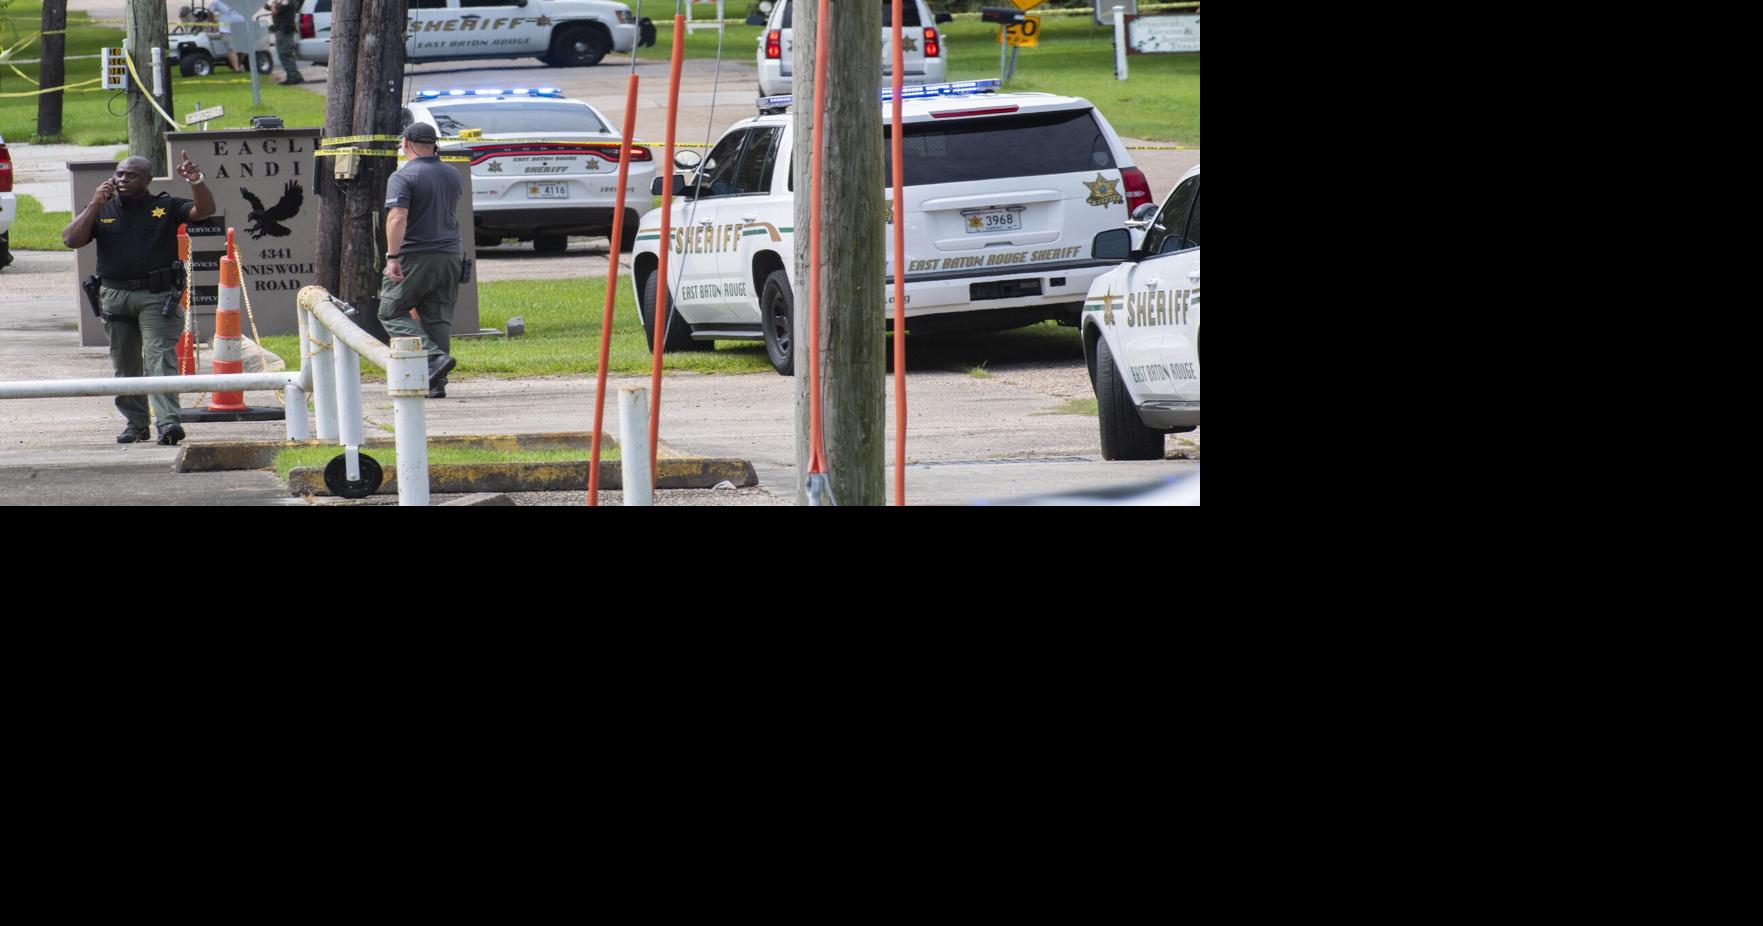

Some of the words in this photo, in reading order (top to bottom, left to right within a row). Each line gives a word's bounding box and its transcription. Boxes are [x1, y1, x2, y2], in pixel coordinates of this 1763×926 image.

[409, 17, 526, 32] SHERIFF
[449, 40, 488, 48] BATON
[216, 161, 301, 179] ANDI
[544, 186, 566, 194] 4116
[985, 213, 1013, 226] 3968
[675, 223, 744, 255] SHERIFF
[260, 248, 292, 259] 4341
[908, 258, 941, 272] EAST
[942, 255, 985, 270] BATON
[986, 251, 1029, 266] ROUGE
[1030, 245, 1083, 262] SHERIFF
[241, 263, 315, 275] NNISWOL
[255, 279, 300, 291] ROAD
[682, 285, 698, 300] EAST
[700, 283, 722, 298] BATON
[724, 282, 747, 297] ROUGE
[1127, 289, 1191, 328] SHERIFF
[1130, 365, 1148, 383] EAST
[1146, 364, 1170, 382] BATON
[1170, 362, 1197, 380] ROUGE
